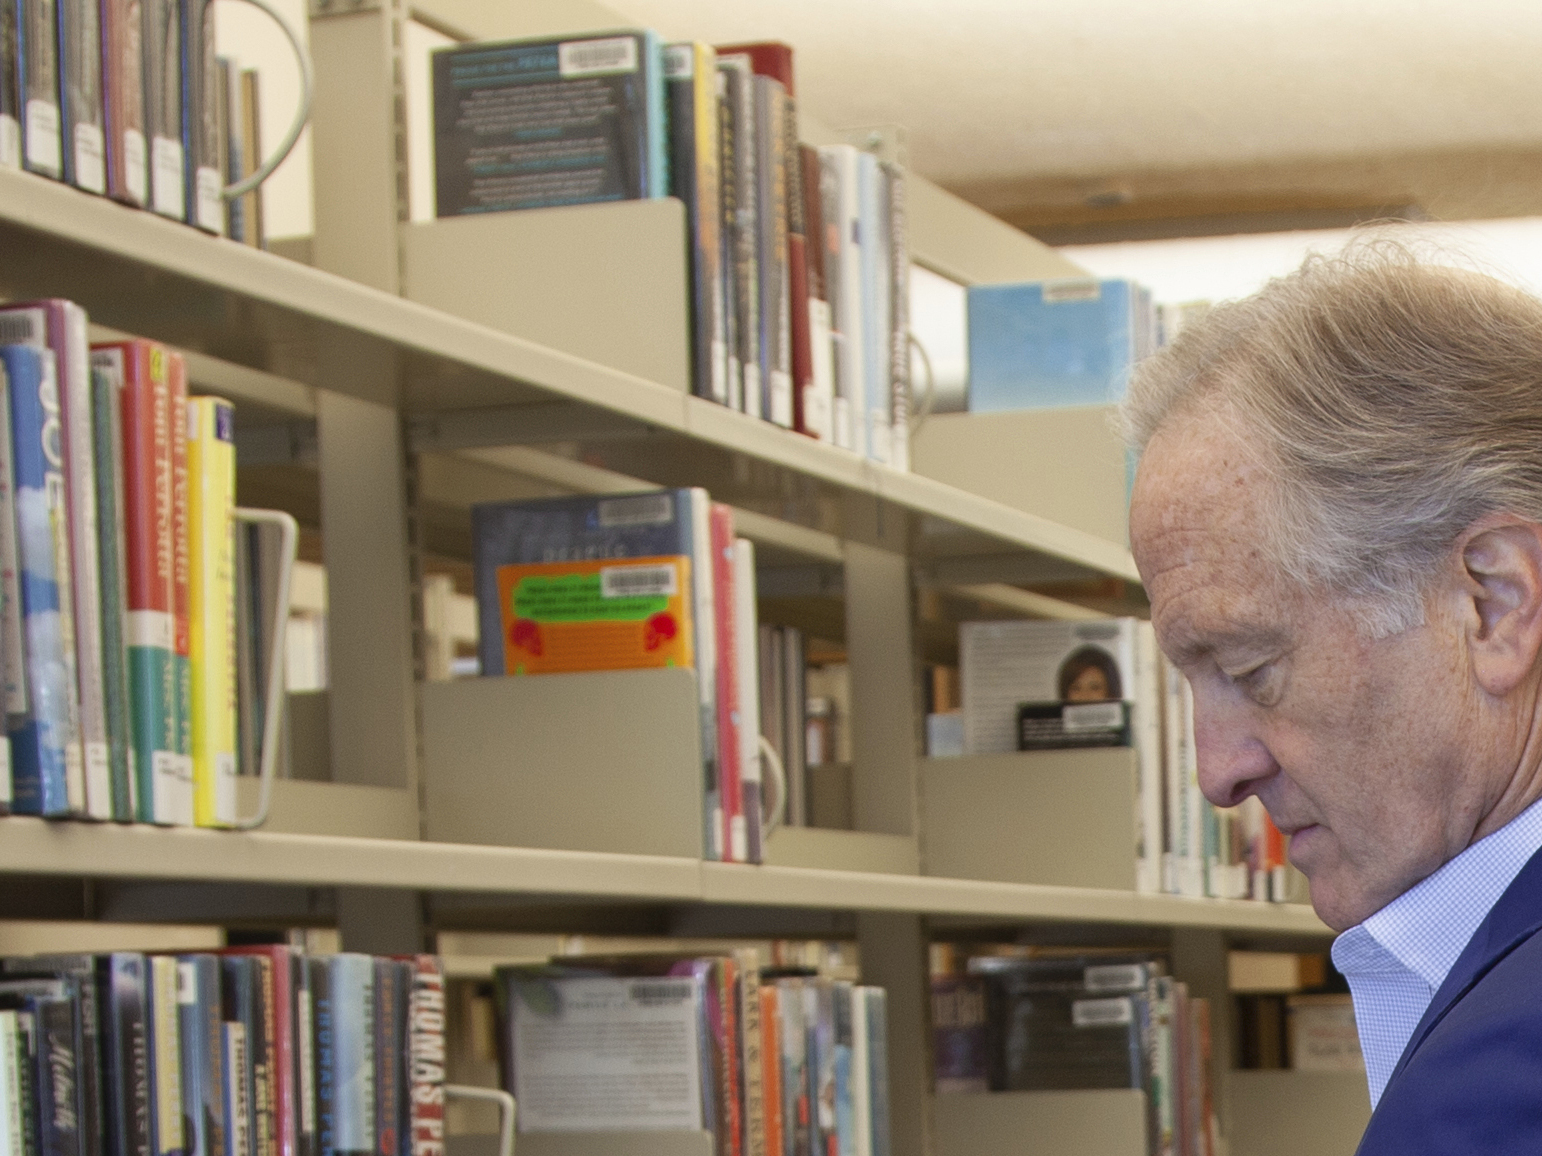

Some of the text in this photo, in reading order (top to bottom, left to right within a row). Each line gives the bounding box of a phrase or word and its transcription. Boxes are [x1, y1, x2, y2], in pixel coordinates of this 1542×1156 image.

[156, 458, 174, 579] Perrotta
[318, 999, 333, 1099] THOMAS
[411, 968, 444, 1106] THOMAS
[745, 970, 759, 1032] LARK
[134, 1021, 151, 1134] THOMAS
[210, 1005, 224, 1118] THOMAS
[237, 1037, 247, 1116] THOMAS
